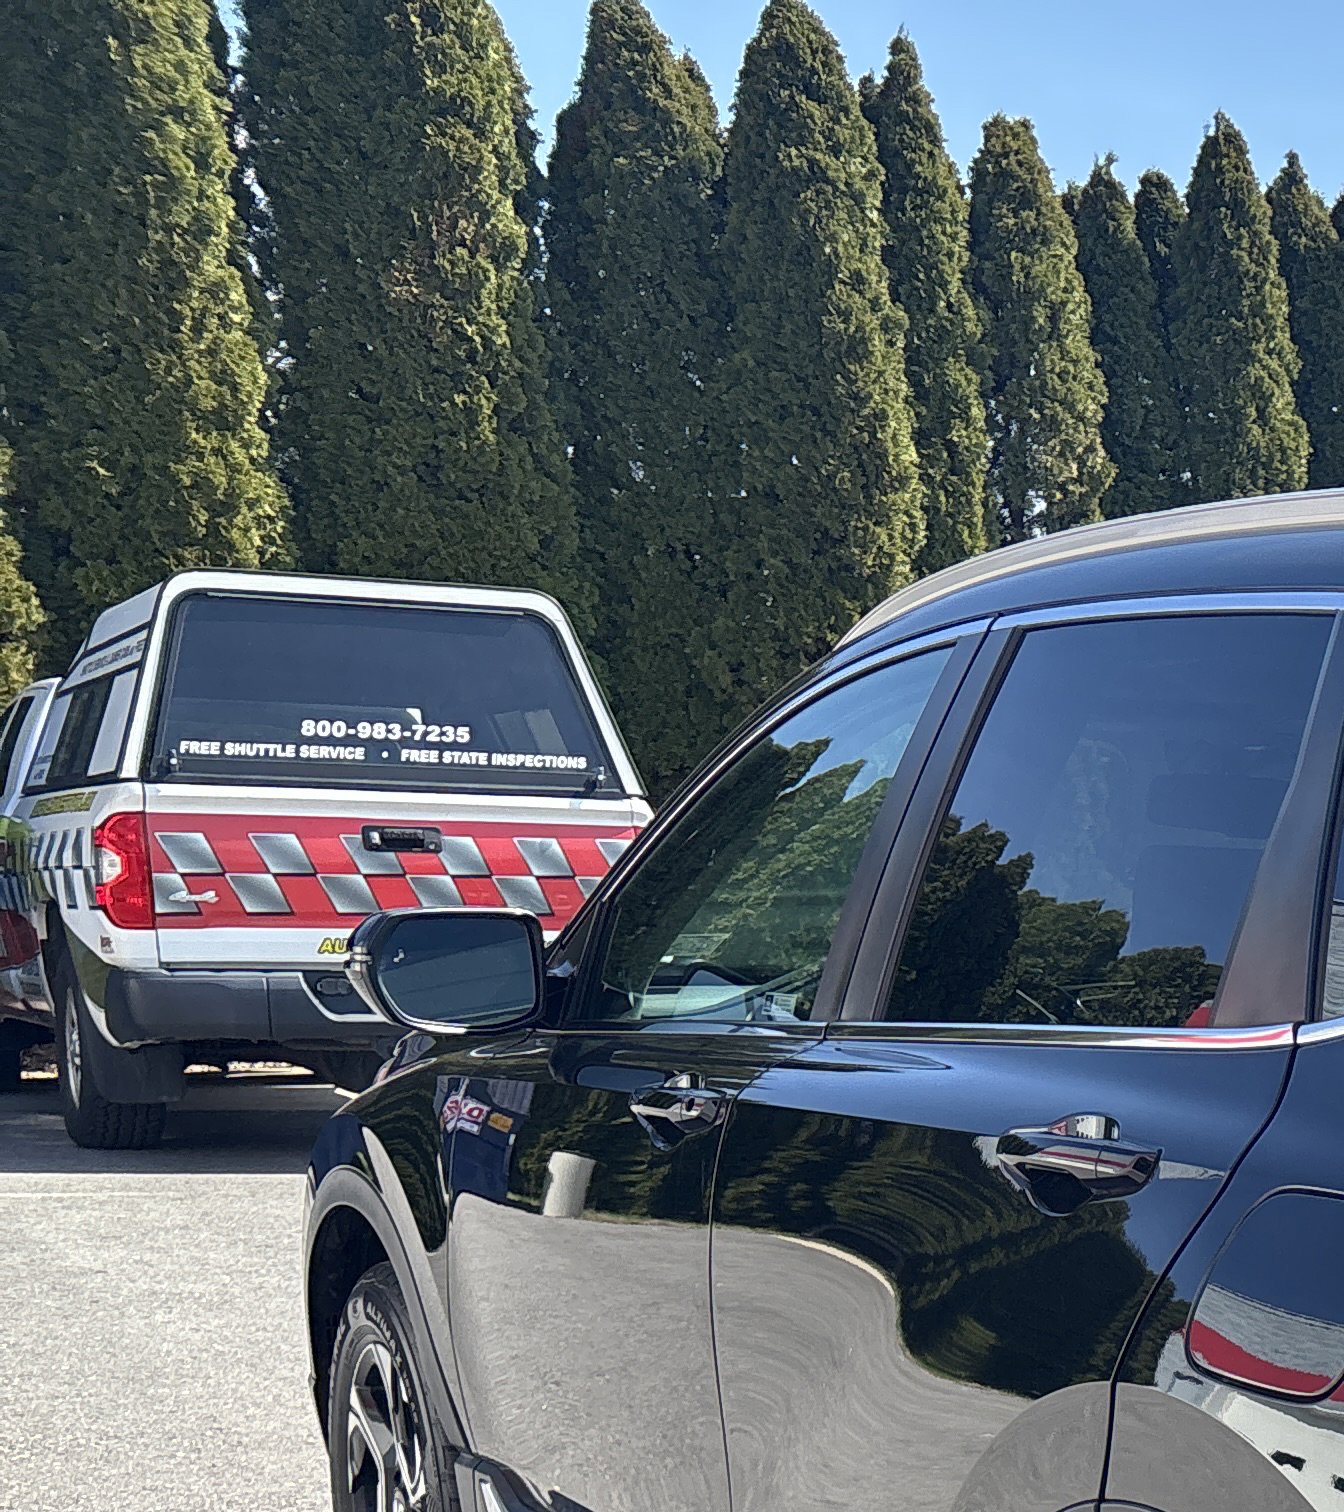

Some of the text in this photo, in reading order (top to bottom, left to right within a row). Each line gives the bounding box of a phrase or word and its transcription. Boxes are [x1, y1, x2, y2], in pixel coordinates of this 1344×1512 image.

[300, 719, 470, 743] 800-983-7235
[179, 740, 587, 769] FREE SHUTTLE SERVICE FREE STATE INSPECTIONS
